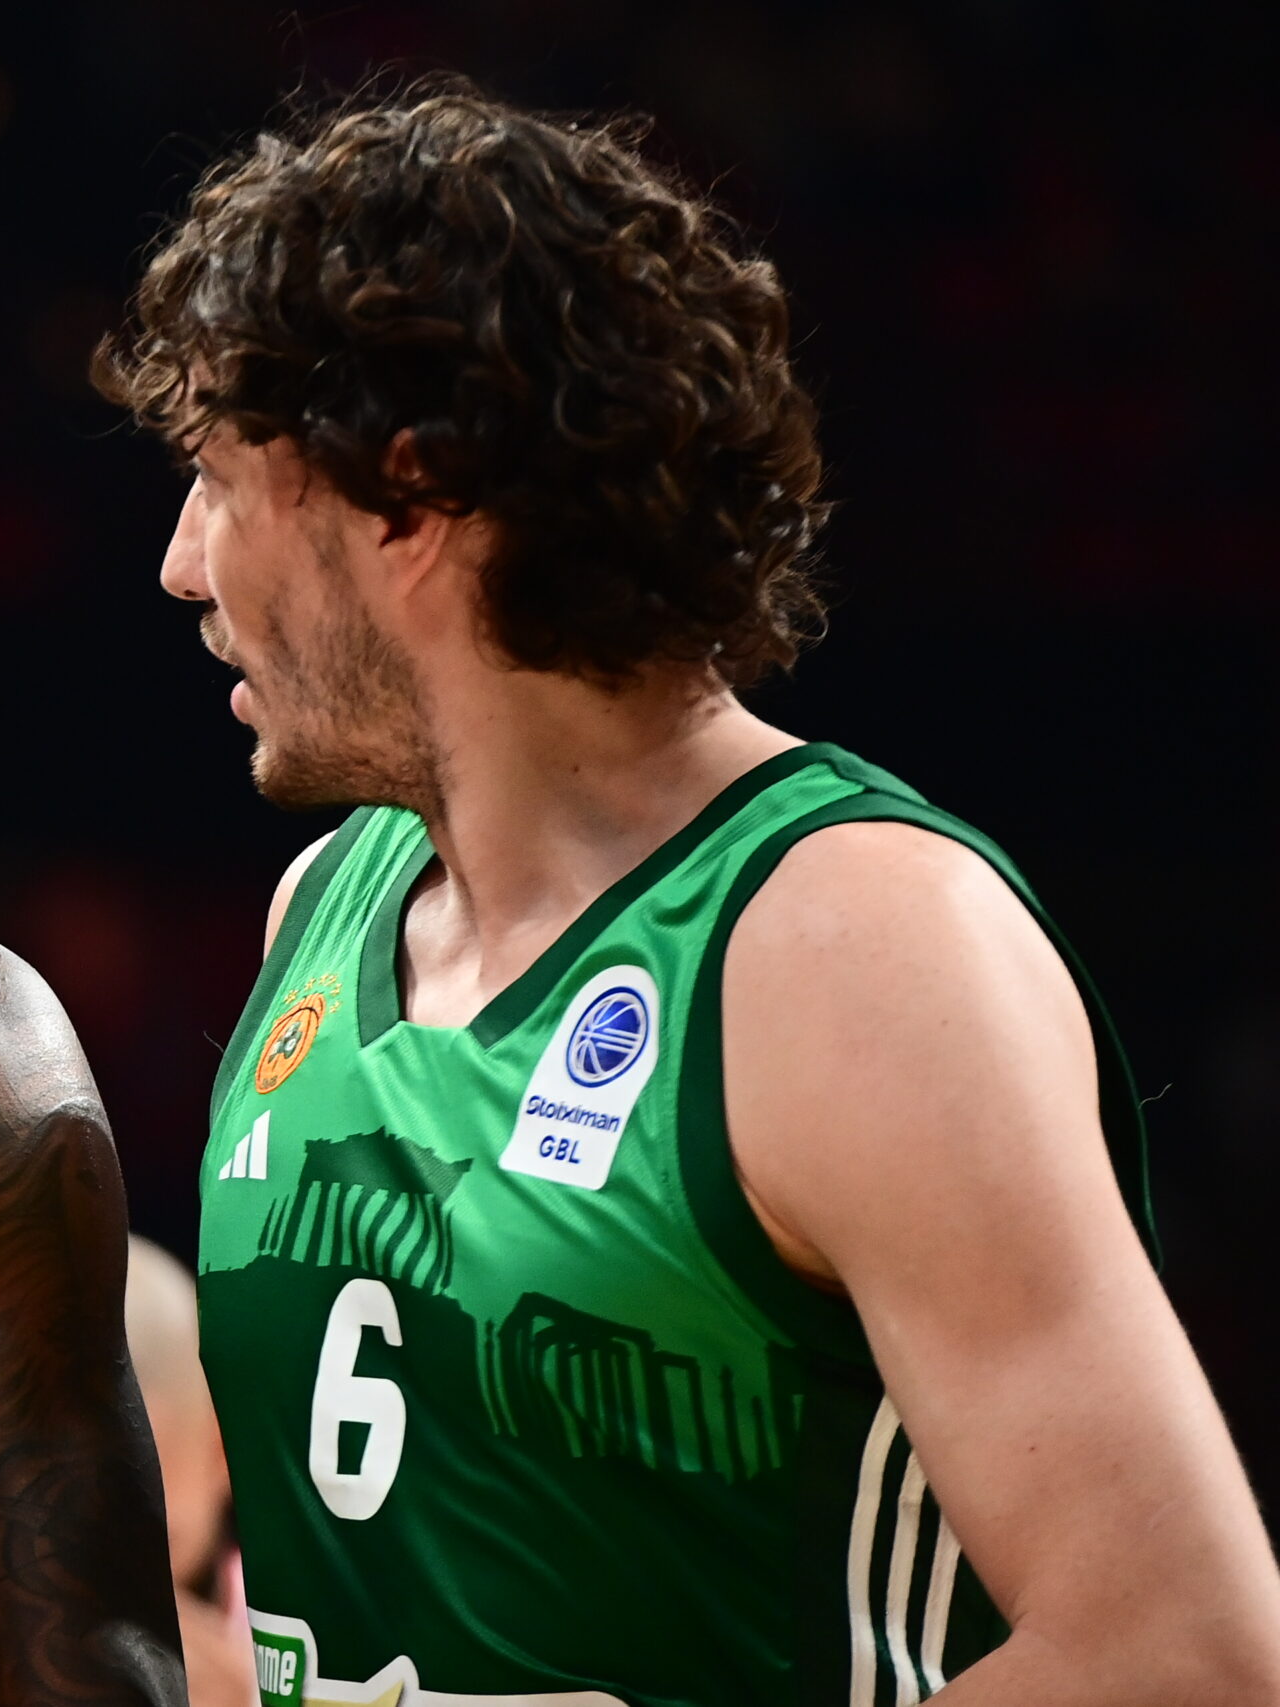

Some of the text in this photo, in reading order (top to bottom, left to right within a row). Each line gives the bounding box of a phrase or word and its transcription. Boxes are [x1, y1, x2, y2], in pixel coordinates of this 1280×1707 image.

[526, 1095, 621, 1133] Stoiximan
[539, 1135, 581, 1164] GBL
[308, 1278, 407, 1521] 6
